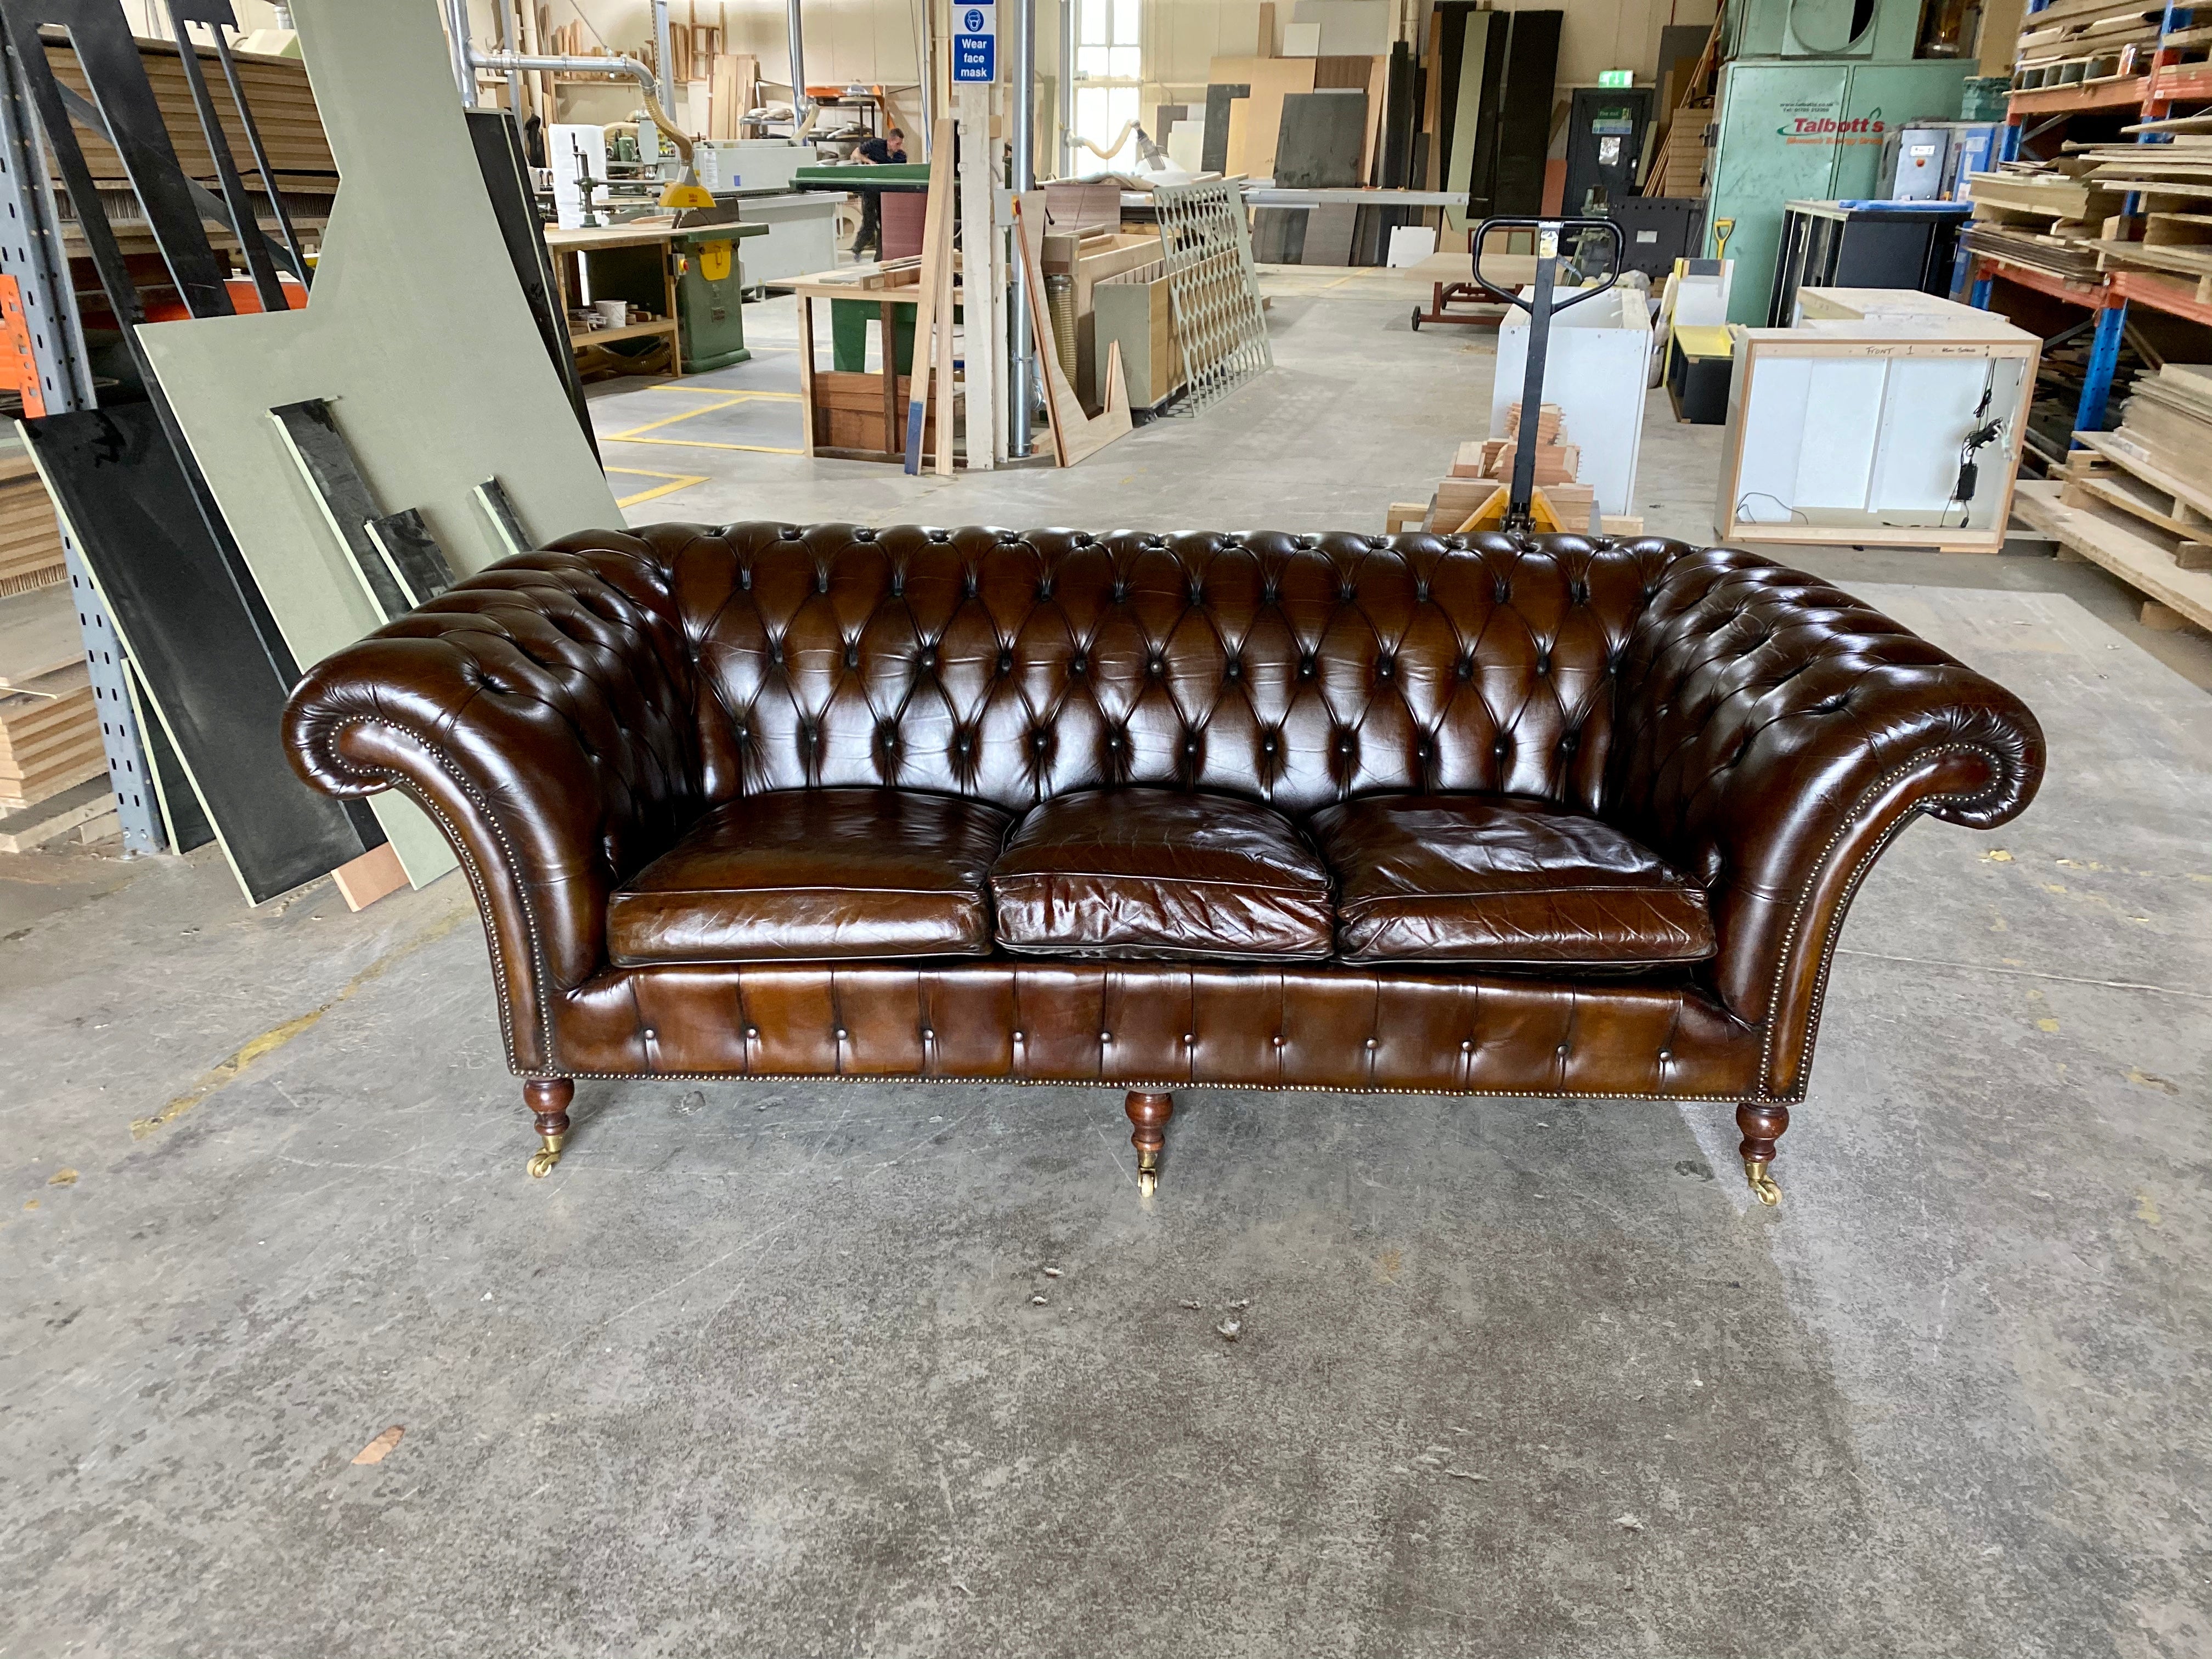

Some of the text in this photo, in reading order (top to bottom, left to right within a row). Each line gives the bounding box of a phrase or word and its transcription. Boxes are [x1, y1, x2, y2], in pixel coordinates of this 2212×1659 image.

[962, 38, 987, 49] Wear
[964, 53, 985, 63] face
[961, 67, 987, 77] mask
[1795, 117, 1884, 133] Talbott's
